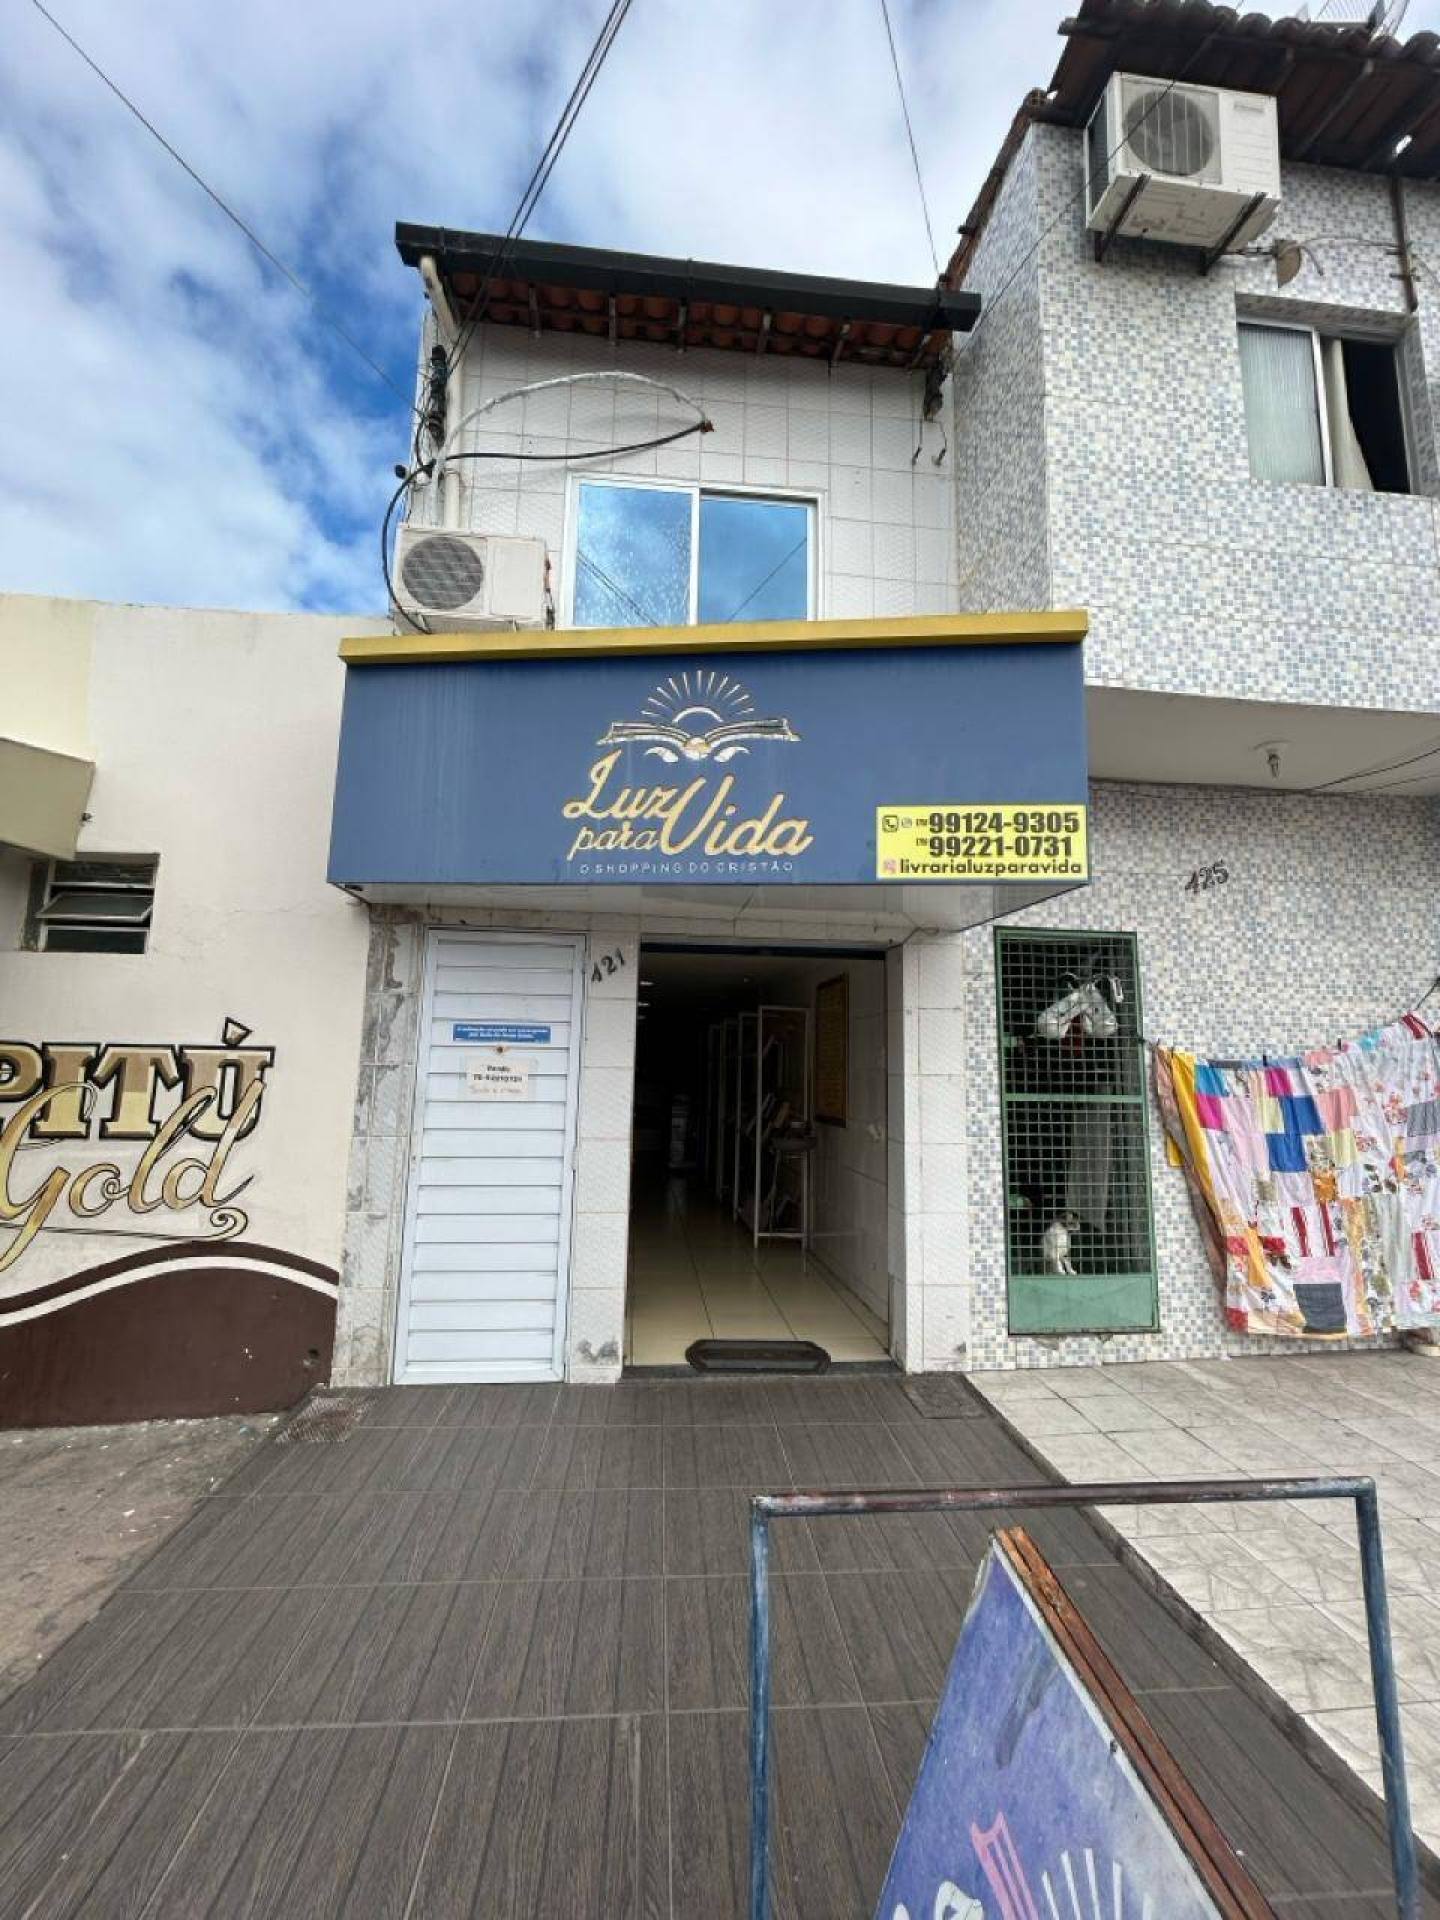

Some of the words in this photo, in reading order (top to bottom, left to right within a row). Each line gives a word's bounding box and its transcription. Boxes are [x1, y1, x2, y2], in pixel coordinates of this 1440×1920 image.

[563, 749, 679, 819] Luz
[566, 820, 661, 861] para
[659, 773, 814, 856] Vida
[929, 812, 1080, 833] 99124-9305
[929, 836, 1073, 857] 99221-0731
[579, 863, 590, 875] O
[594, 862, 682, 875] SHOPPING
[688, 861, 710, 874] DO
[717, 859, 794, 874] CRISTÃO
[900, 859, 1082, 877] livrarialuzparavida
[591, 948, 626, 982] 421
